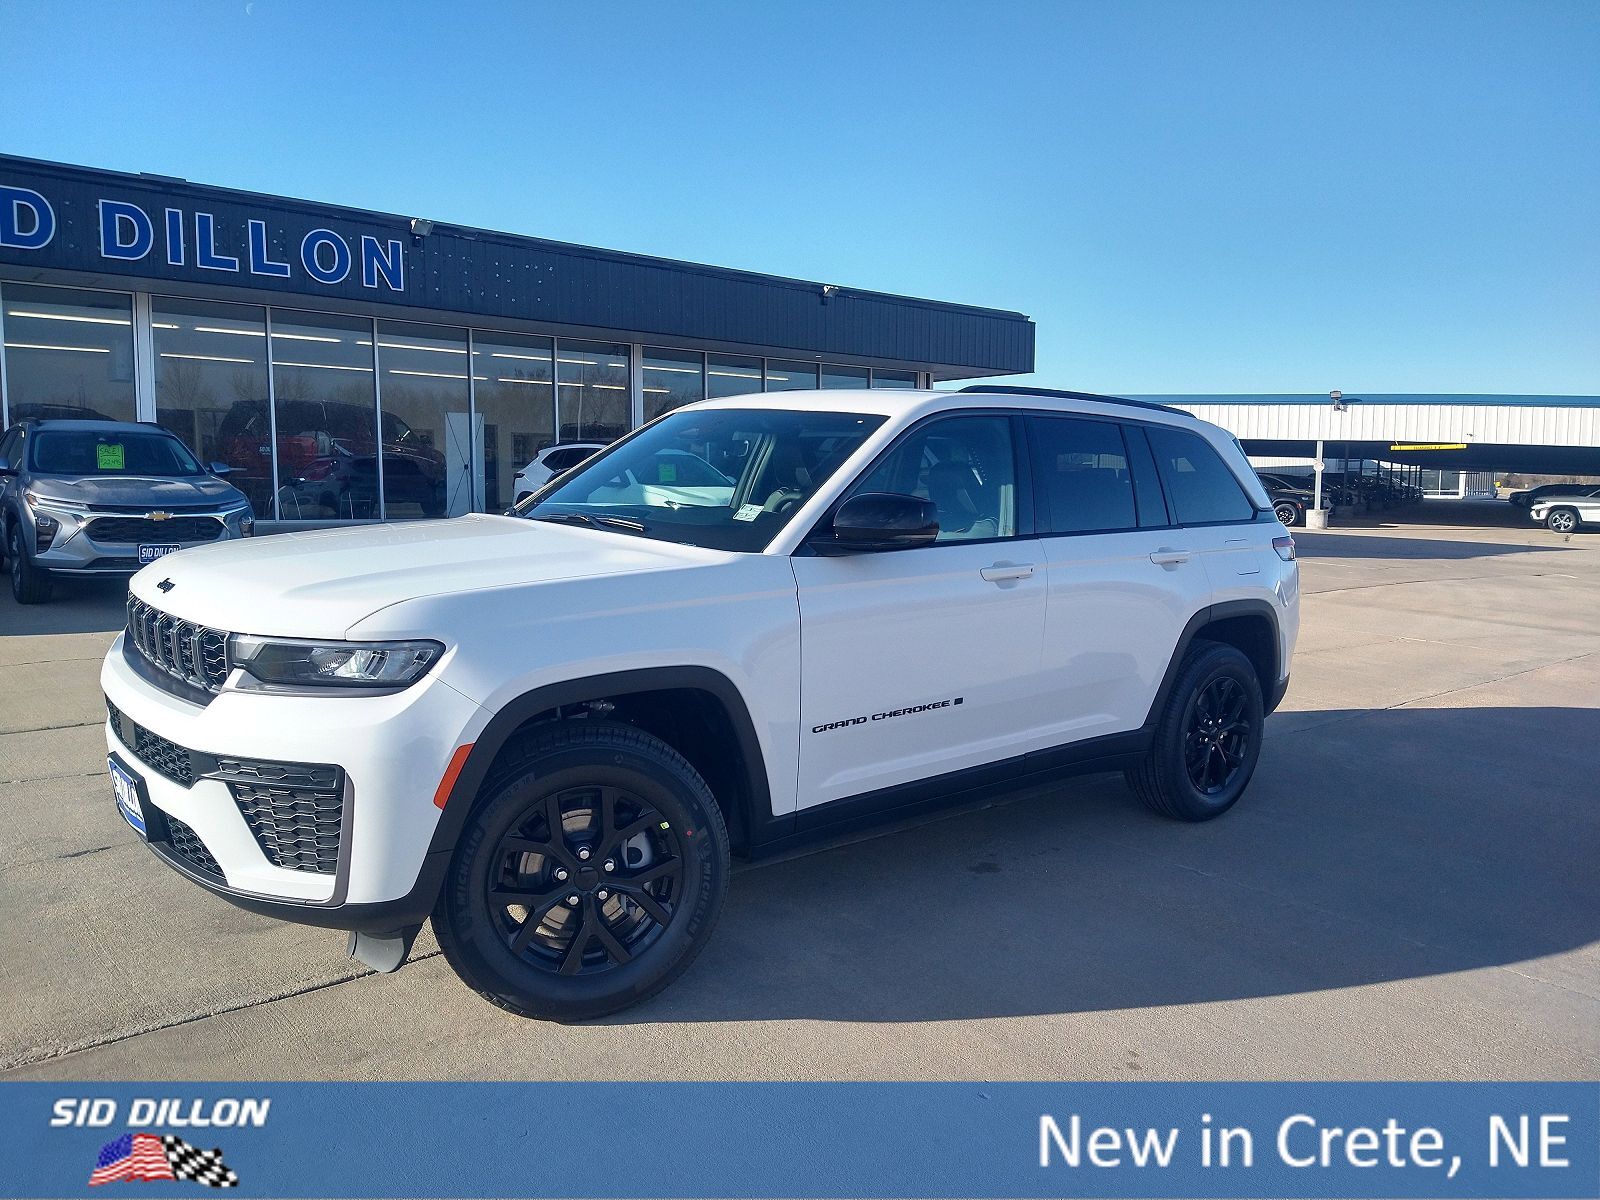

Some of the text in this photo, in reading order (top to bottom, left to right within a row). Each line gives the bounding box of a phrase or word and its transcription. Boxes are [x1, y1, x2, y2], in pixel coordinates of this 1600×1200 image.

[99, 199, 405, 292] DILLON
[141, 547, 154, 558] SID
[811, 699, 951, 734] GRAND CHEROKEE
[687, 861, 713, 938] MICHELIN
